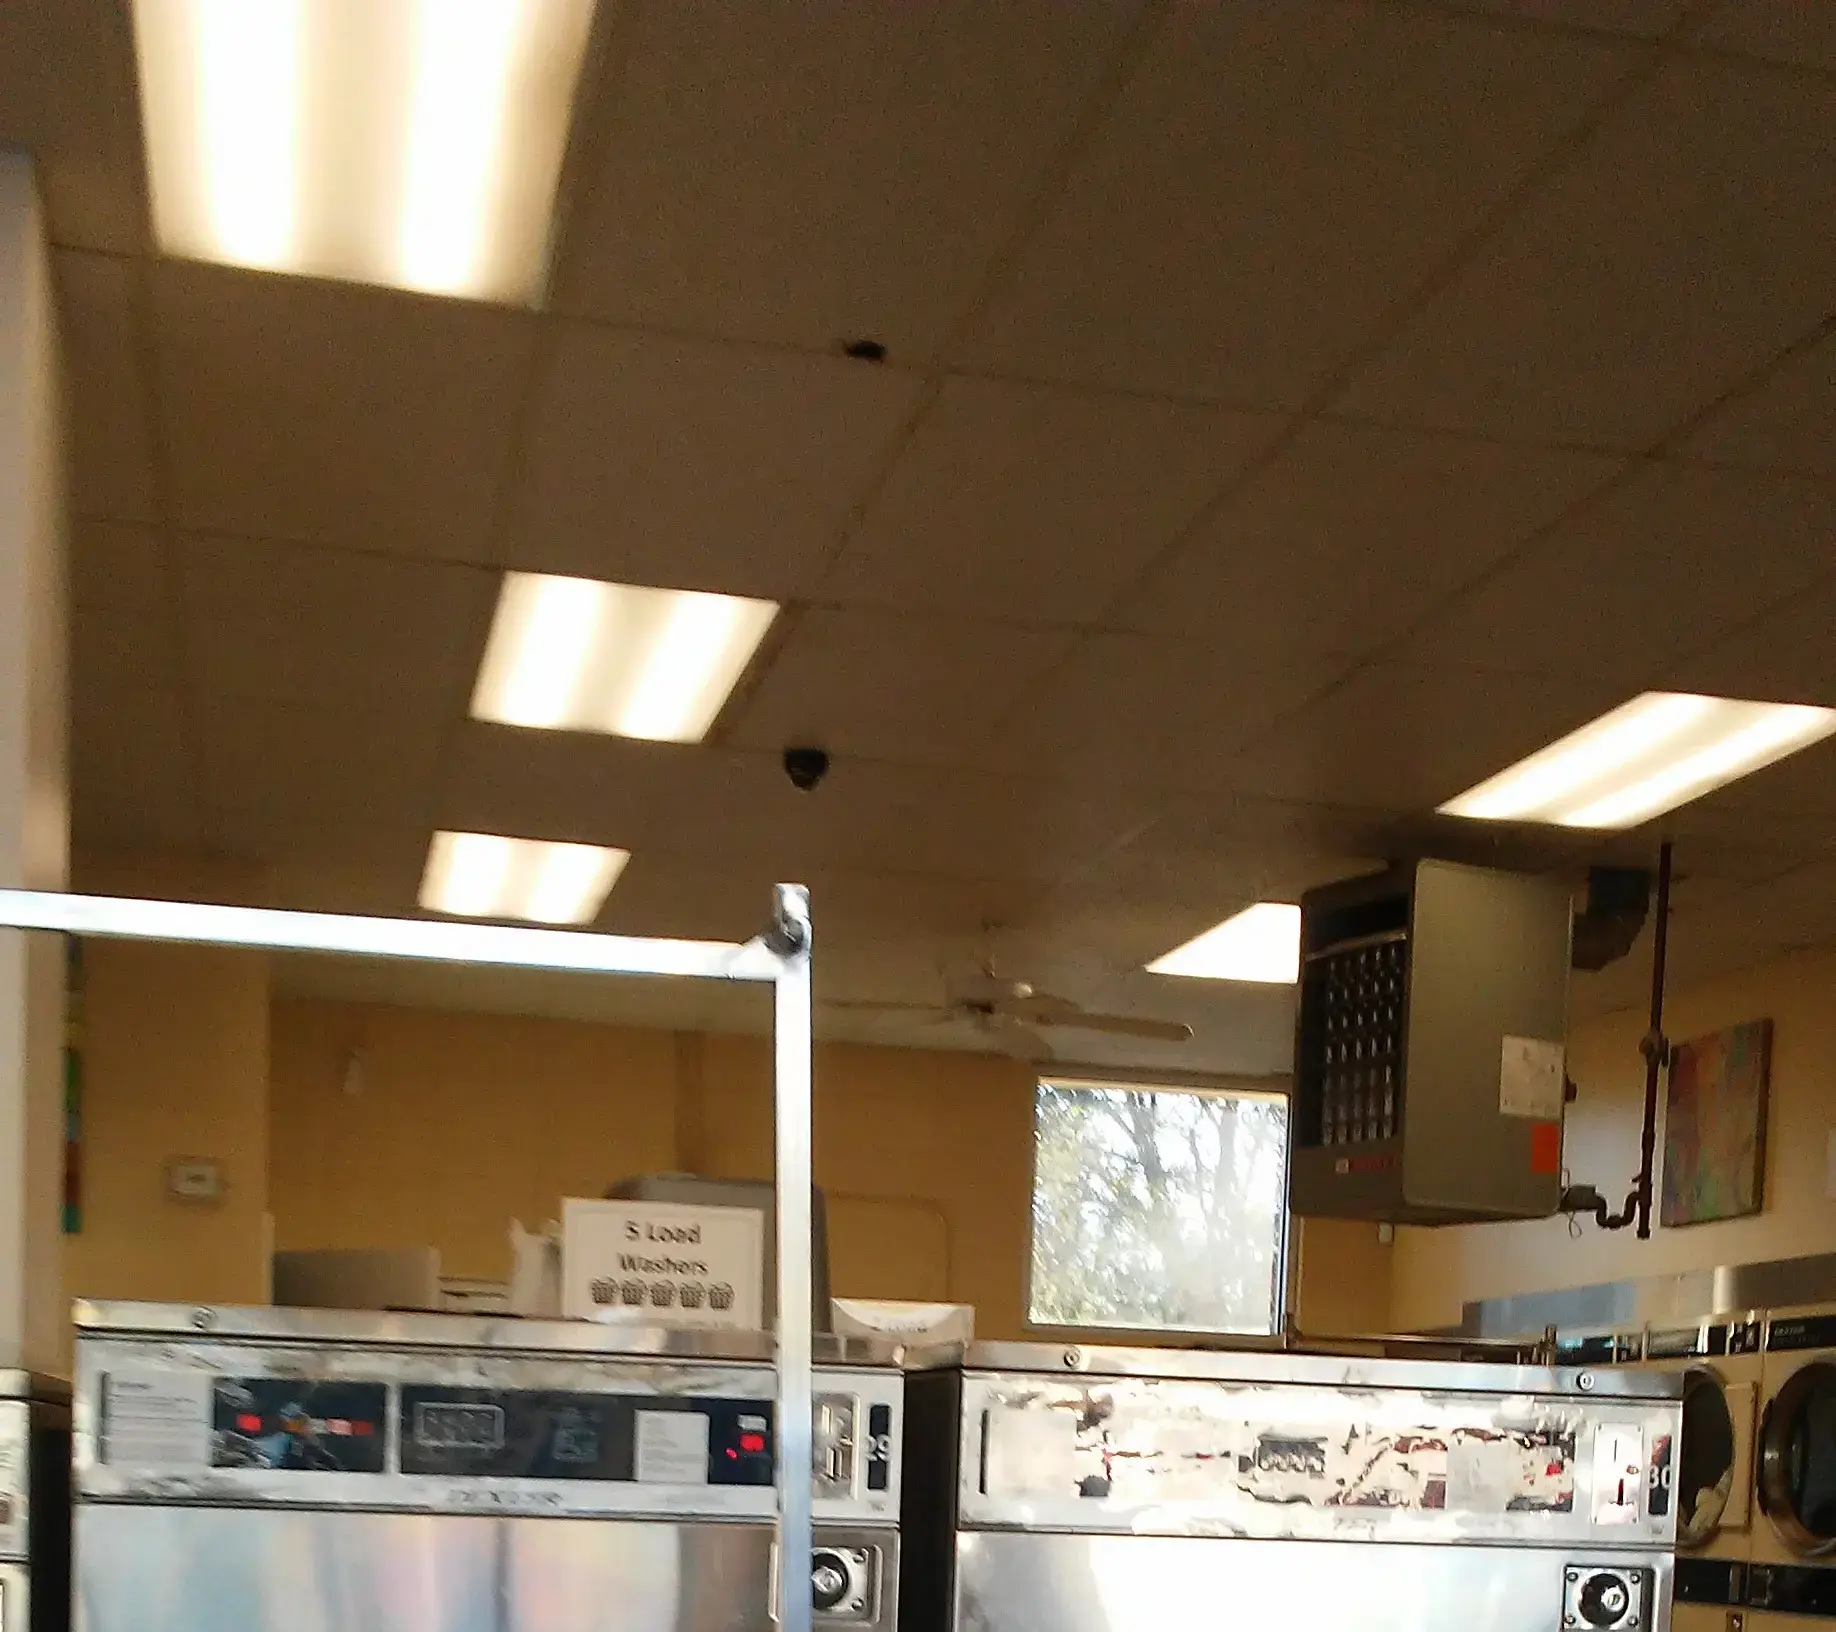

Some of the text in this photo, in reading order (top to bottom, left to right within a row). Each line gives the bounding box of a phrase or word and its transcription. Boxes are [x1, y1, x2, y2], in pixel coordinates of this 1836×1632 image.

[646, 1221, 702, 1244] Load
[617, 1252, 709, 1276] Washers
[1648, 1463, 1672, 1489] 30
